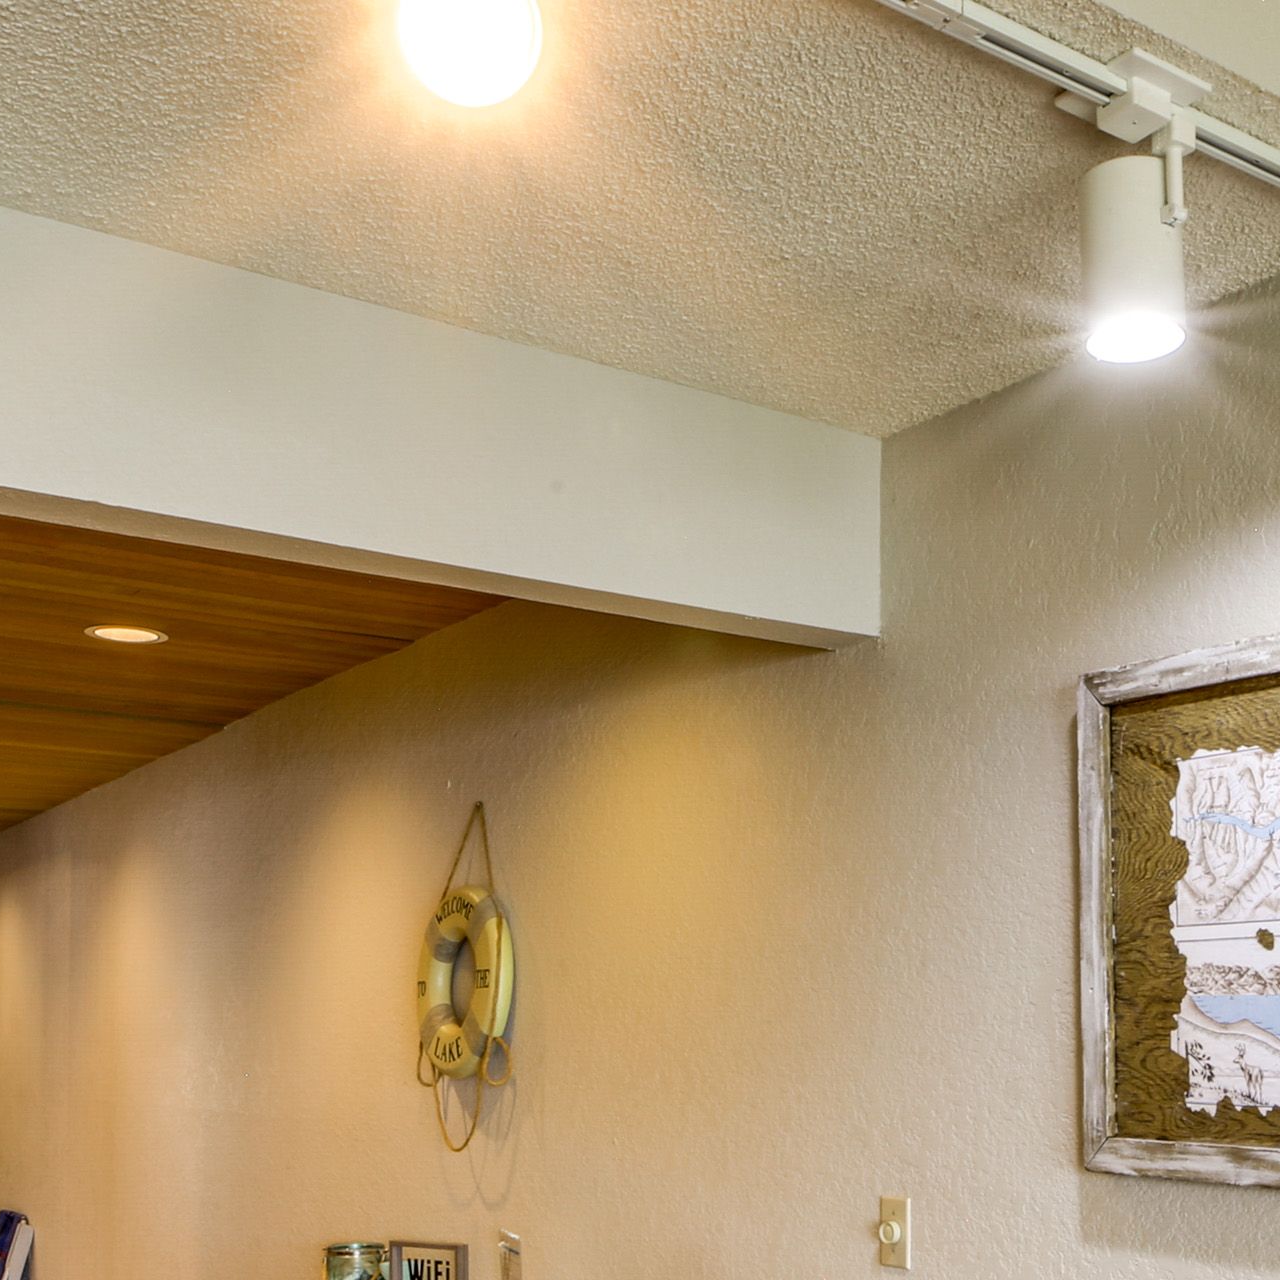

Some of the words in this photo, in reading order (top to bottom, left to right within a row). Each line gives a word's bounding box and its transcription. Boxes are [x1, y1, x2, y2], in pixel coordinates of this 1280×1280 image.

[435, 895, 474, 925] WELCOME
[417, 981, 427, 999] TO
[475, 969, 491, 989] THE
[433, 1036, 464, 1063] LAKE
